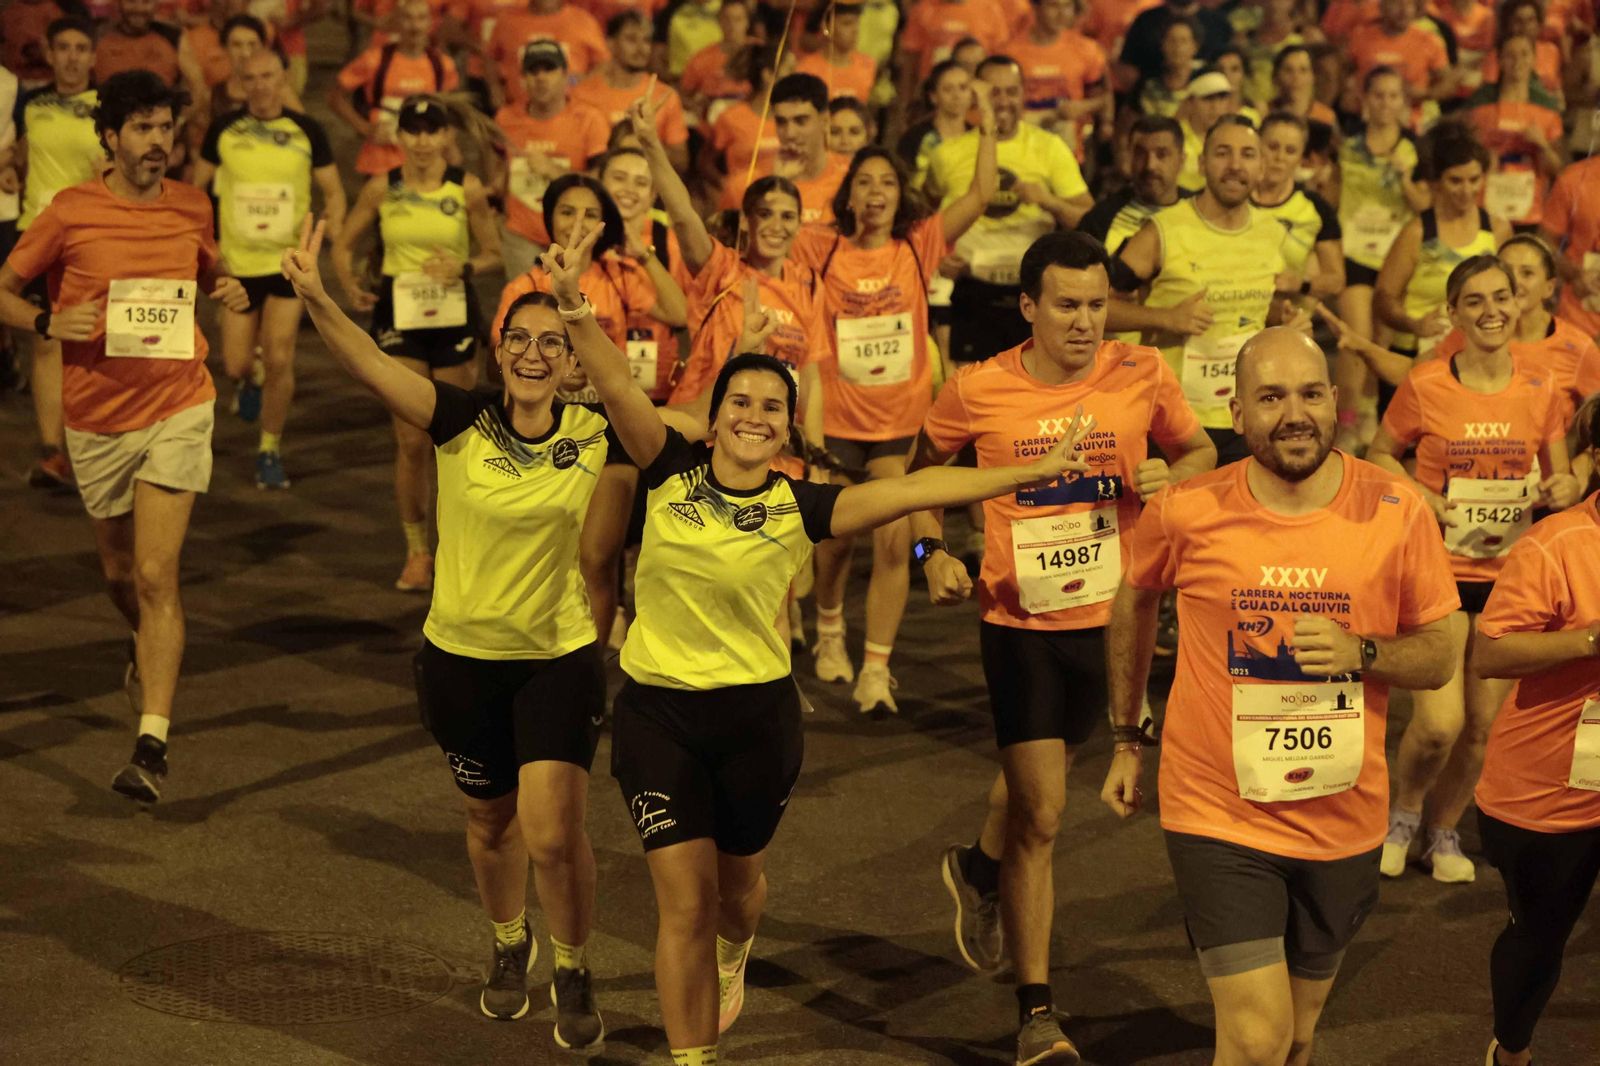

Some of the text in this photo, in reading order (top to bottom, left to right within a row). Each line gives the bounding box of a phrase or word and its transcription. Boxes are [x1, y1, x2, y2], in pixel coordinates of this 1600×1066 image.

[125, 307, 179, 324] 13567
[855, 339, 900, 358] 16122
[1464, 422, 1511, 439] XXXV
[1013, 437, 1059, 447] CARRERA
[1450, 447, 1527, 456] GUADALQUIVIR
[666, 506, 704, 532] ESMONSUR
[1465, 507, 1523, 523] 15428
[1036, 542, 1102, 571] 14987
[1260, 566, 1328, 588] XXXV
[1231, 588, 1351, 601] CARRERA NOCTURNA
[1239, 599, 1351, 614] GUADALQUIVIR
[1265, 726, 1332, 750] 7506
